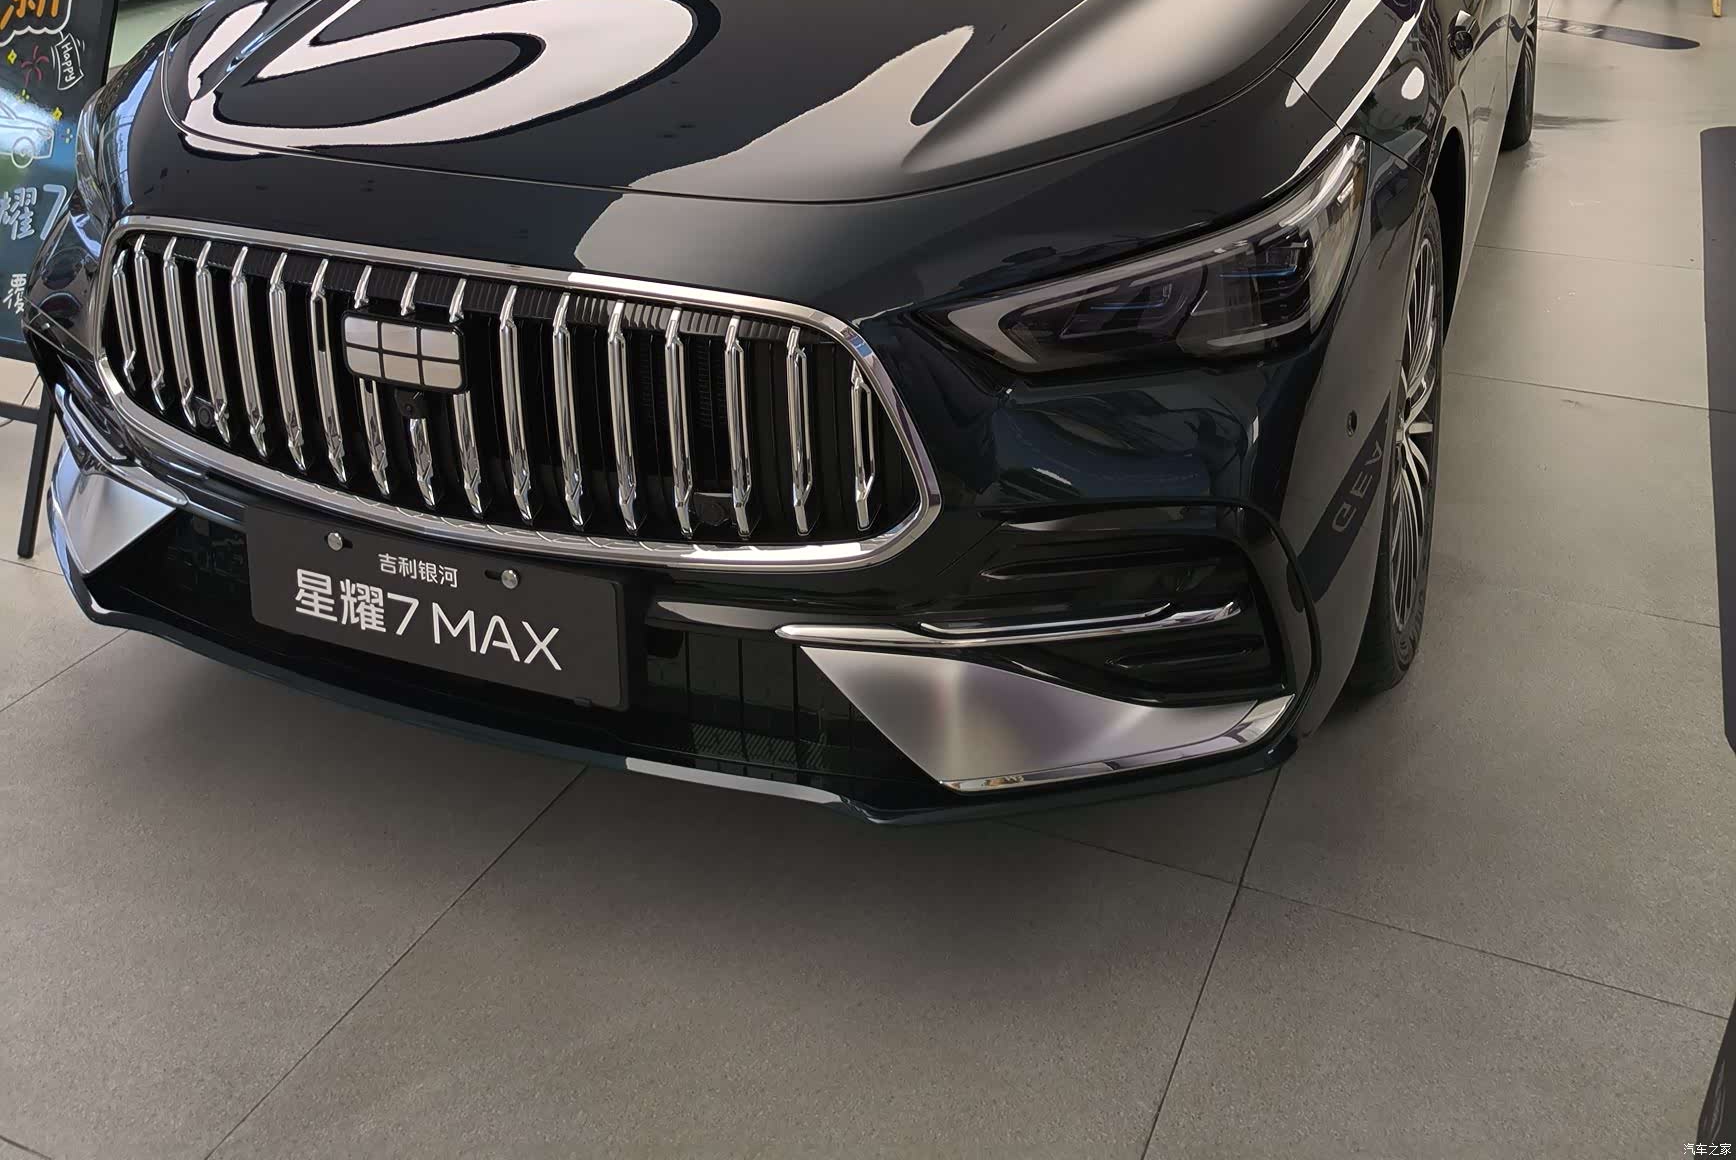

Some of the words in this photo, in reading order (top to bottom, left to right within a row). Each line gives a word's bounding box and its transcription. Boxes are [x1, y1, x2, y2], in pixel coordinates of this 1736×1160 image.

[61, 42, 77, 82] Happy
[377, 552, 458, 589] 吉利银河
[295, 567, 420, 636] 星耀7
[431, 601, 562, 671] MAX
